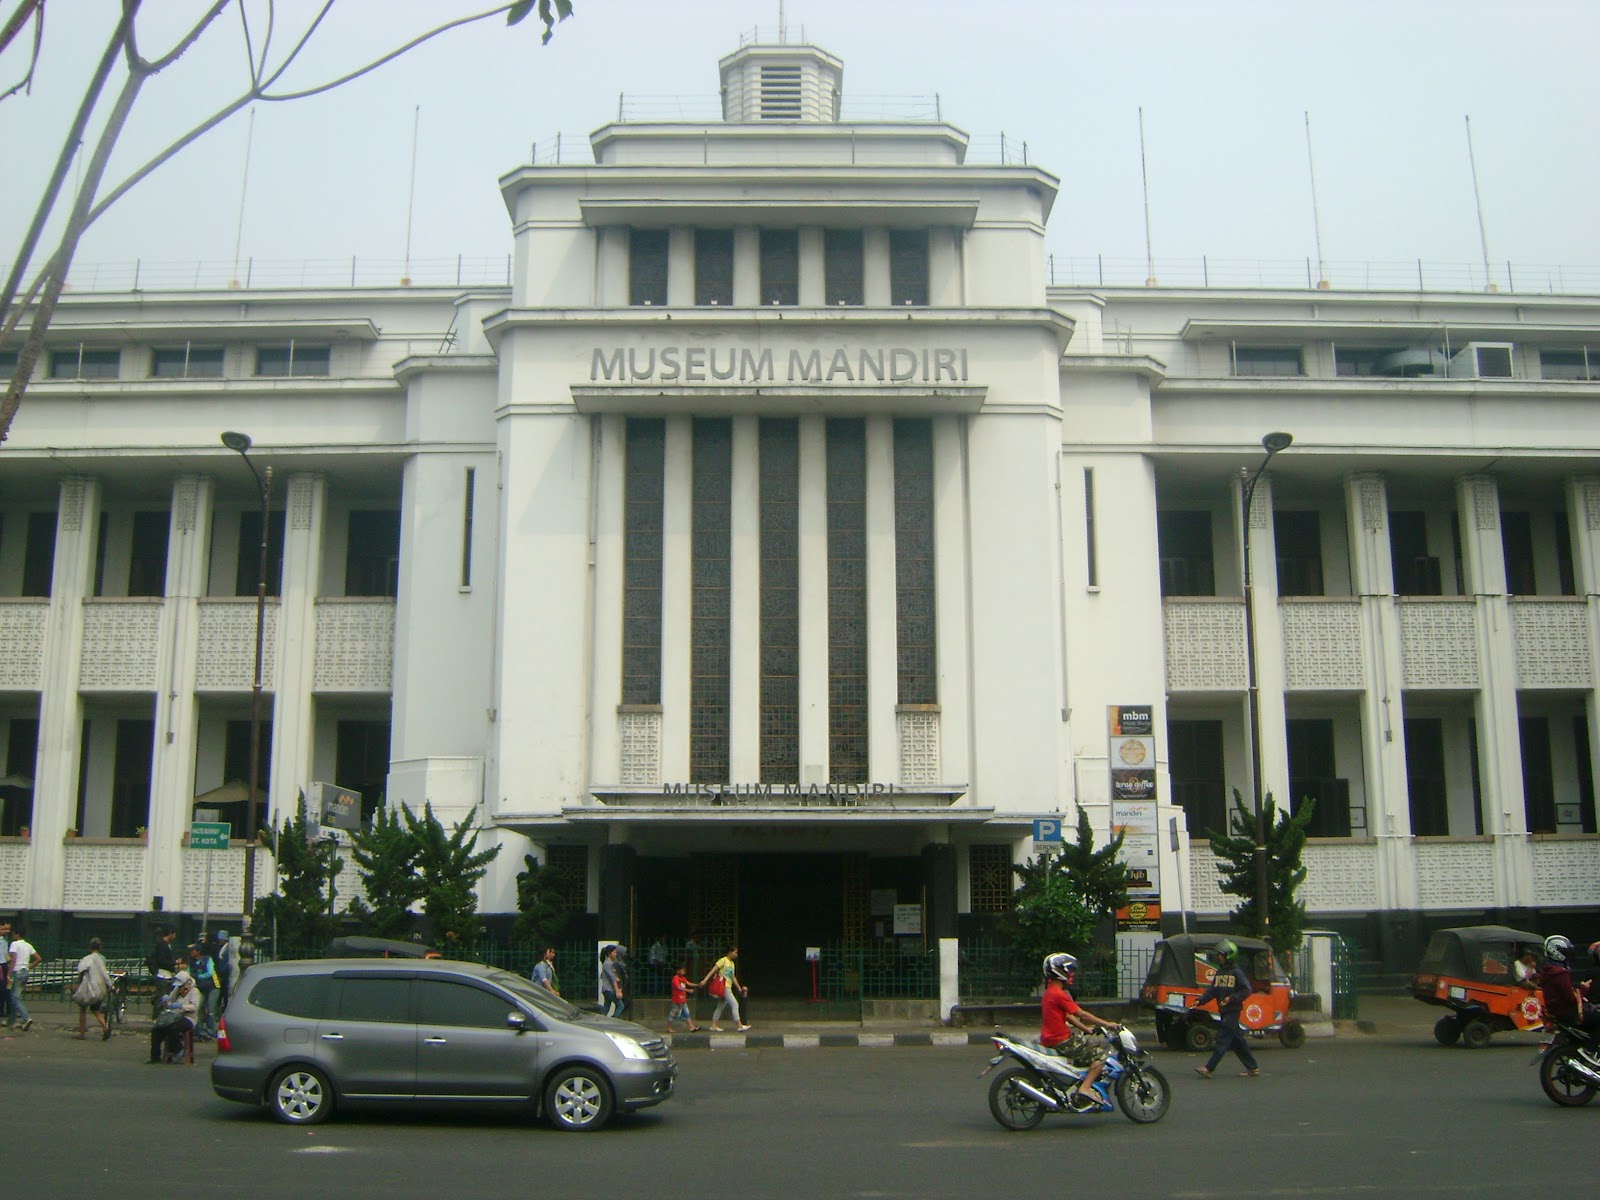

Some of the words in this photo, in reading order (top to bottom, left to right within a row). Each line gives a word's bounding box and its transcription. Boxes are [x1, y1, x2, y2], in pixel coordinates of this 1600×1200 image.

[591, 347, 774, 380] MUSEUM
[788, 348, 968, 381] MANDIRI
[1122, 711, 1149, 720] mbm
[663, 783, 772, 801] MUSEUM
[783, 783, 894, 801] MANDIRI
[1039, 821, 1056, 840] P
